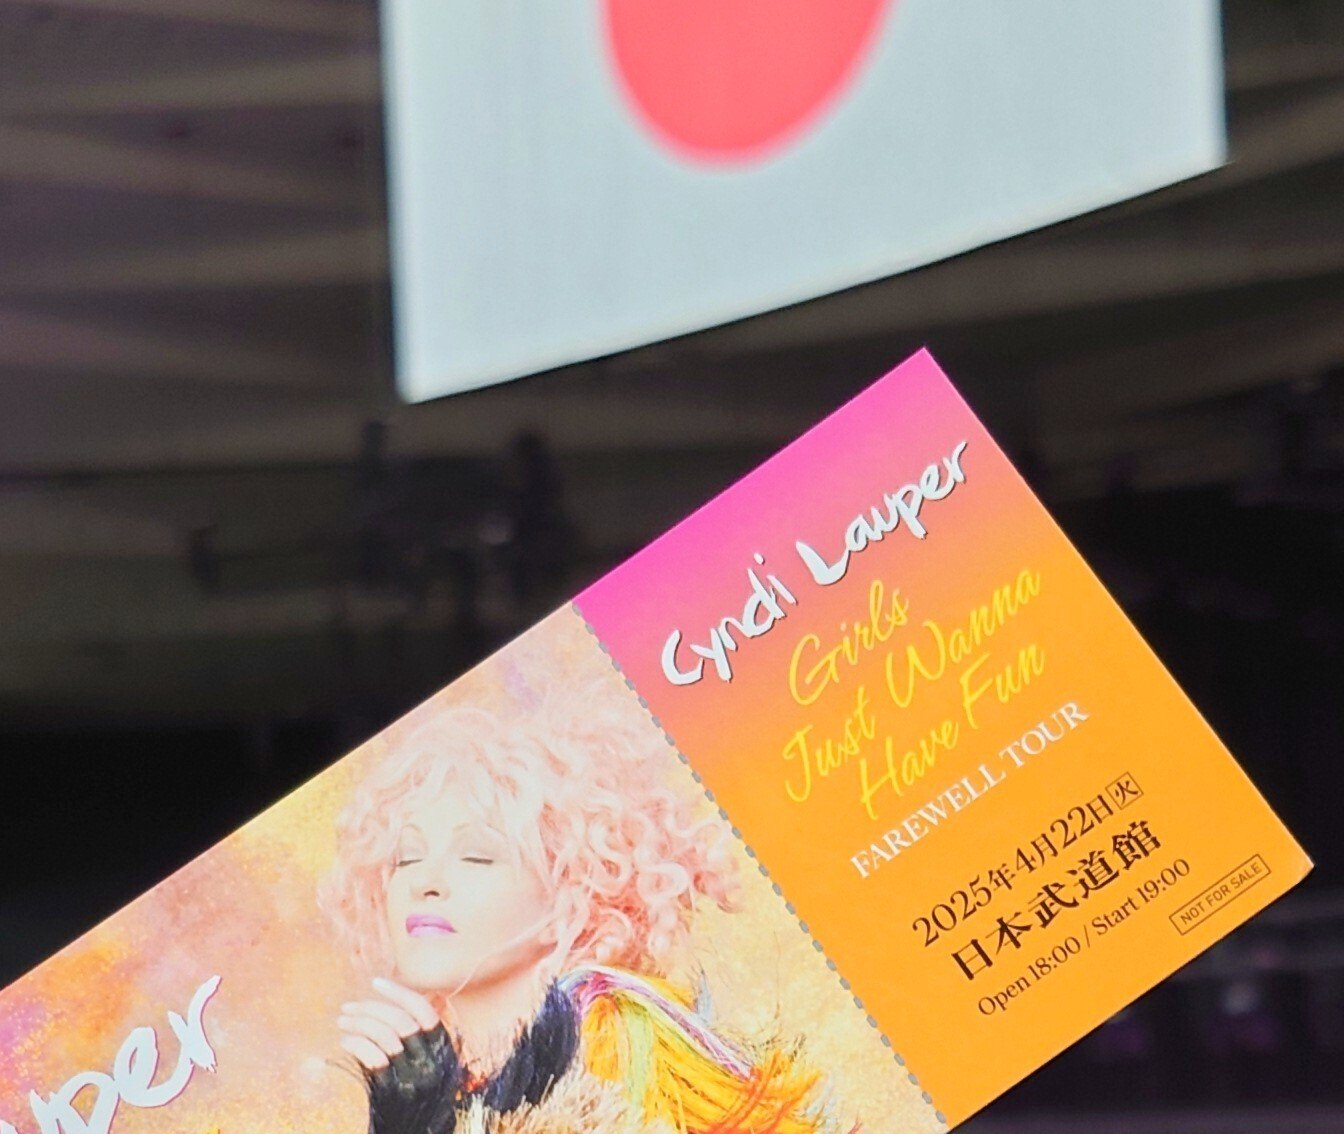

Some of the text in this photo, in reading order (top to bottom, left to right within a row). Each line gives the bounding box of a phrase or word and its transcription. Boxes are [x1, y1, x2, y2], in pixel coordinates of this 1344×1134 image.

[662, 441, 968, 685] Cyndi Lauper
[789, 580, 909, 705] Girls
[783, 569, 1040, 802] Just Wanna
[861, 644, 1045, 820] Have Fun
[850, 702, 1091, 878] FAREWELL TOUR
[951, 820, 1161, 980] 日本武道館
[978, 974, 1031, 1016] Open
[1030, 936, 1081, 982] 18:00
[1092, 898, 1140, 936] Start
[1141, 859, 1190, 903] 19:00
[1180, 862, 1262, 925] NOT FOR SALE
